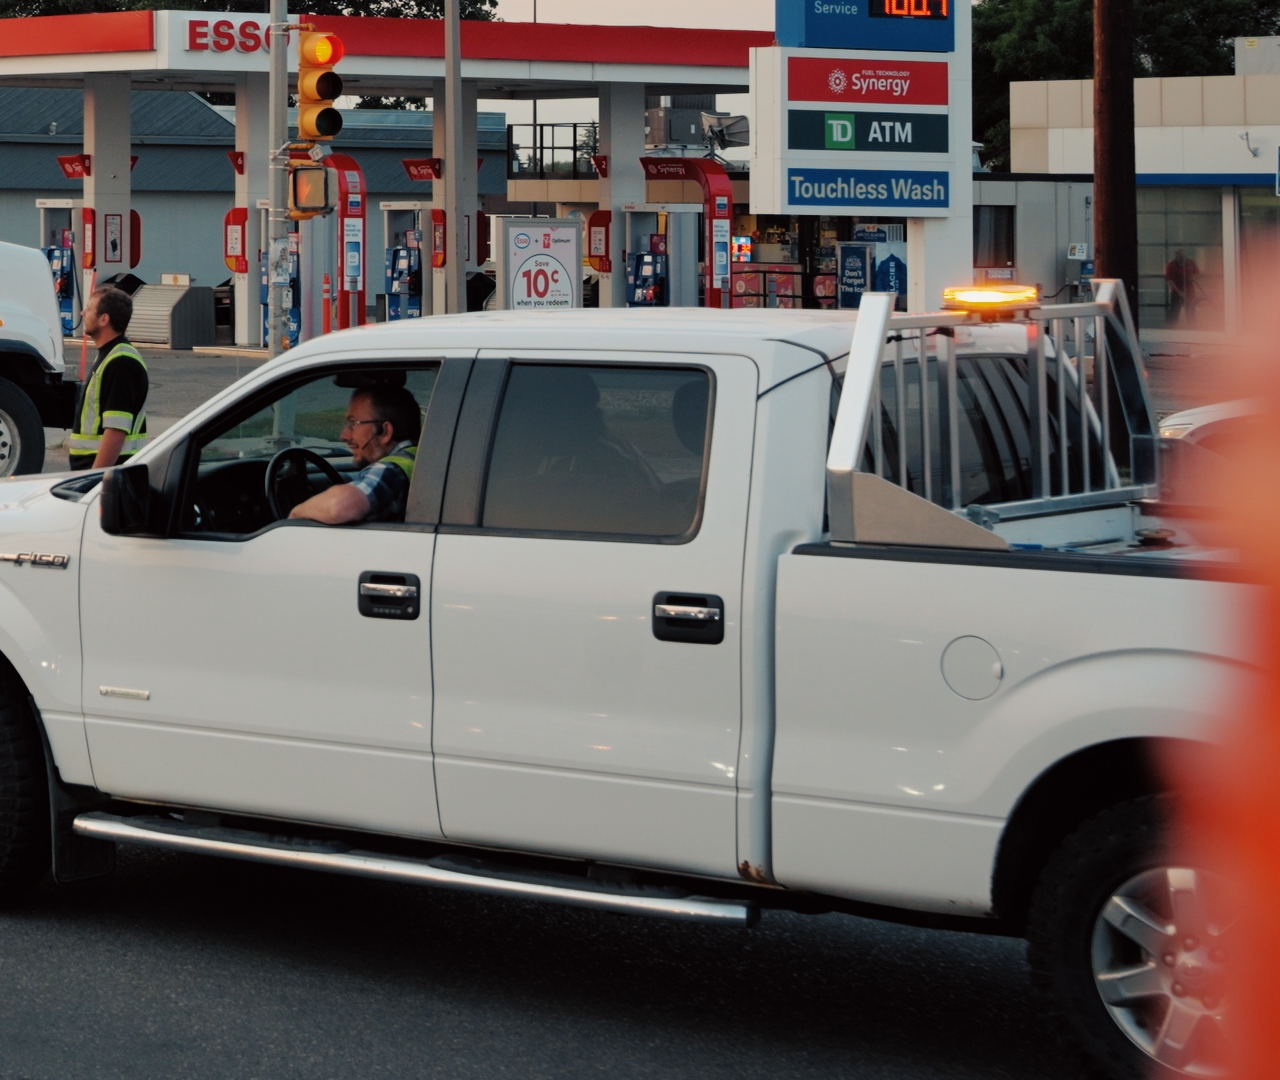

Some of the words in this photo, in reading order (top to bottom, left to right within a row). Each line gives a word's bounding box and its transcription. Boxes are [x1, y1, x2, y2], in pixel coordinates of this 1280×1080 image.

[814, 0, 858, 15] Service
[851, 73, 910, 96] Synergy
[827, 119, 853, 142] TD
[868, 121, 912, 143] ATM
[601, 160, 606, 169] 2
[657, 165, 686, 175] Synergy
[791, 176, 888, 200] Touchless
[891, 178, 945, 201] Wash
[843, 277, 864, 285] Forget
[841, 285, 853, 293] The
[533, 300, 544, 308] you
